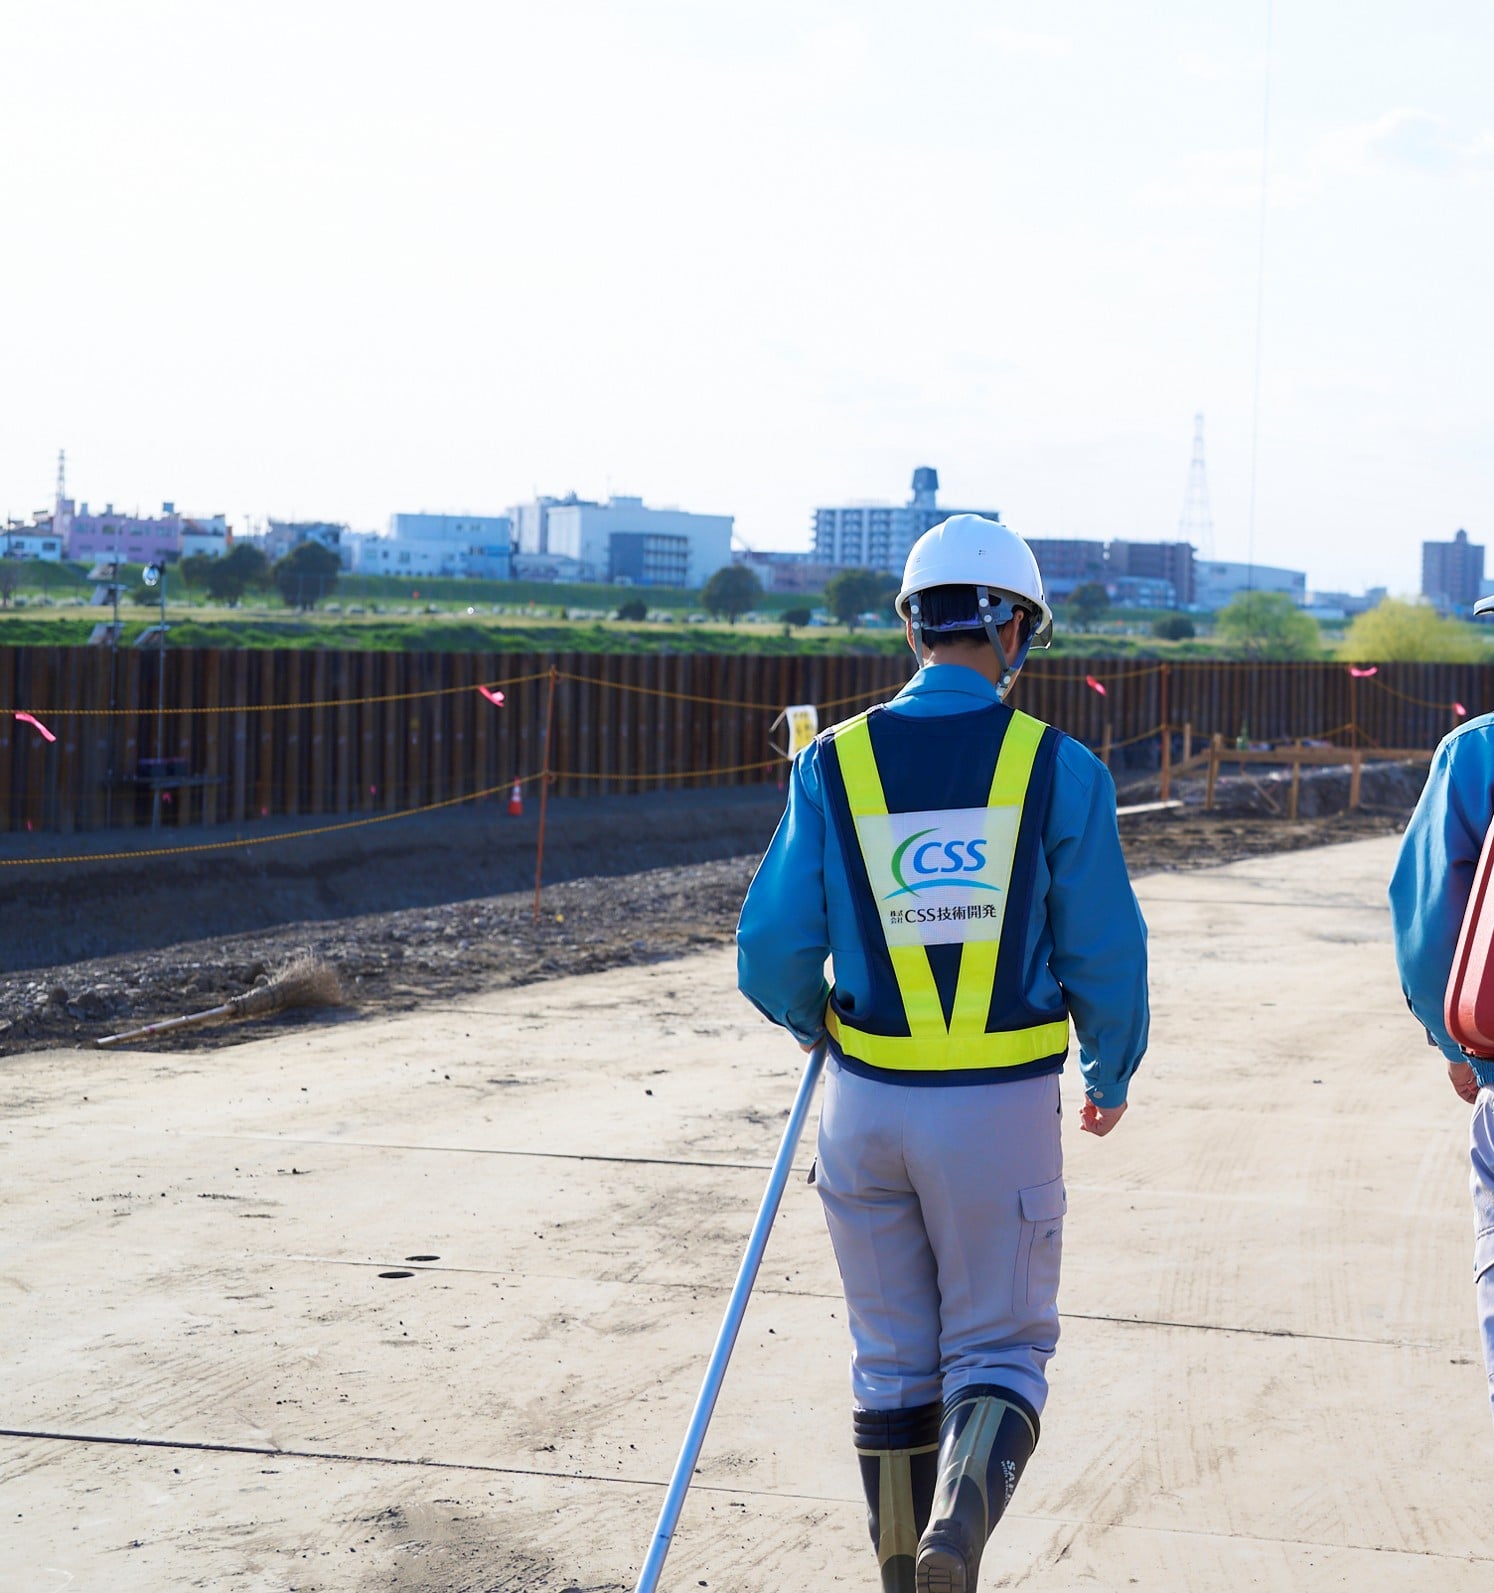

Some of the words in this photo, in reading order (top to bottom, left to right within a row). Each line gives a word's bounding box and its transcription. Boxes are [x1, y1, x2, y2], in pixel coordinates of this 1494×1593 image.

[913, 838, 987, 874] CSS
[904, 904, 997, 923] CSS技術開発
